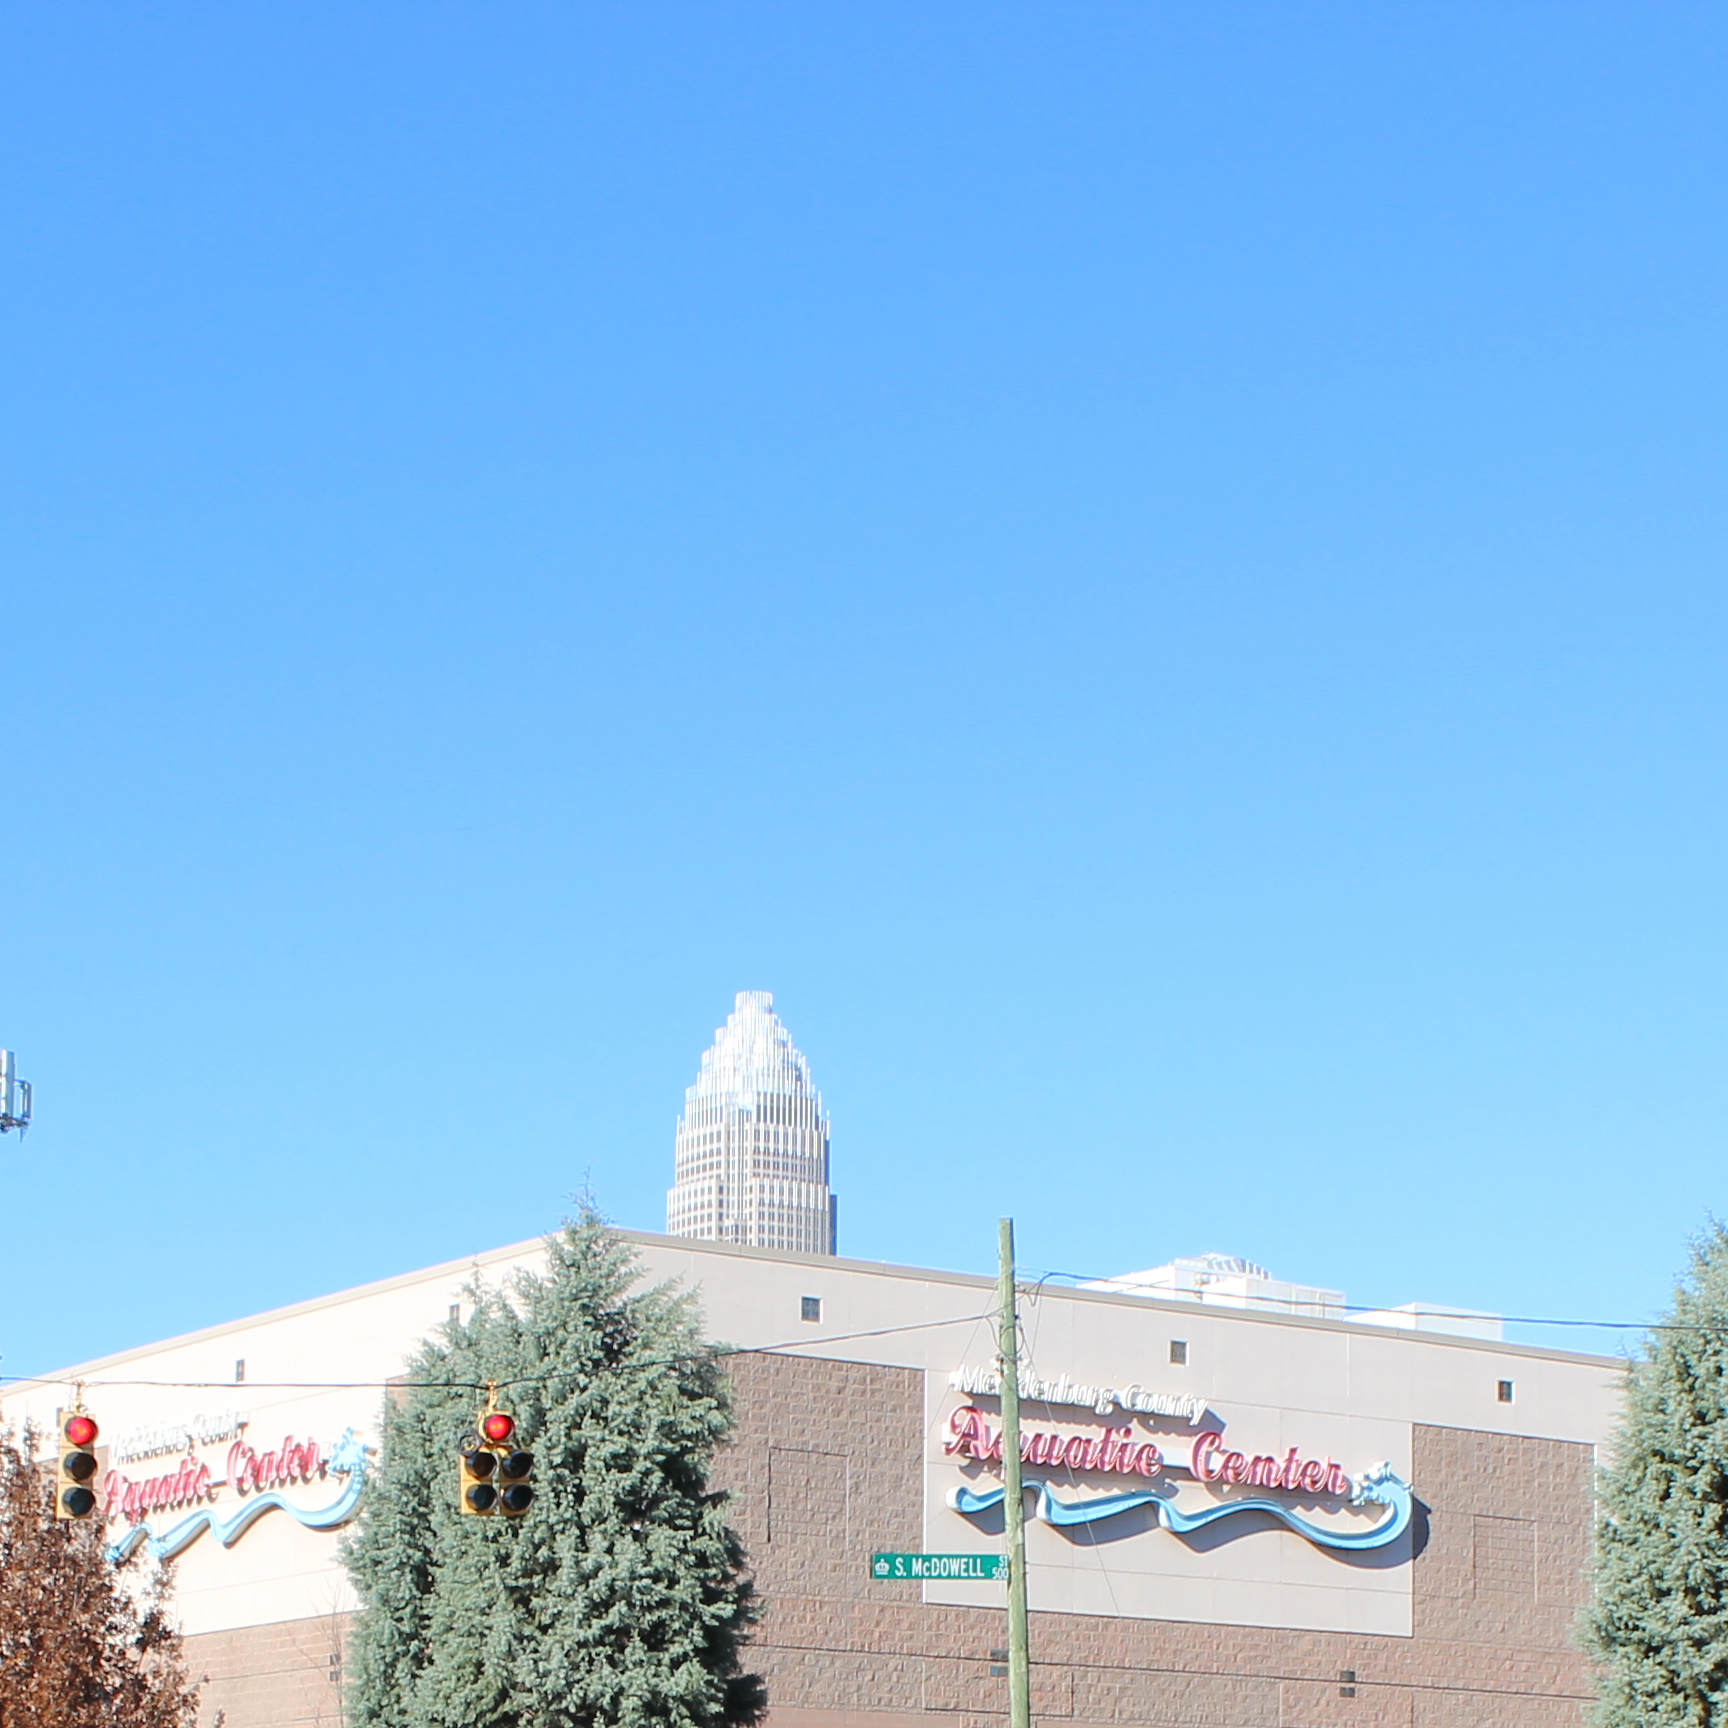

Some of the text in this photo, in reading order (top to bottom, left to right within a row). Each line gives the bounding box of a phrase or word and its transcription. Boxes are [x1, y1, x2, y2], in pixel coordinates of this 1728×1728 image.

[1120, 1381, 1209, 1426] County
[1188, 1431, 1349, 1494] Center
[894, 1557, 907, 1577] S.
[911, 1557, 985, 1577] McDOWELL
[991, 1567, 1009, 1579] 500
